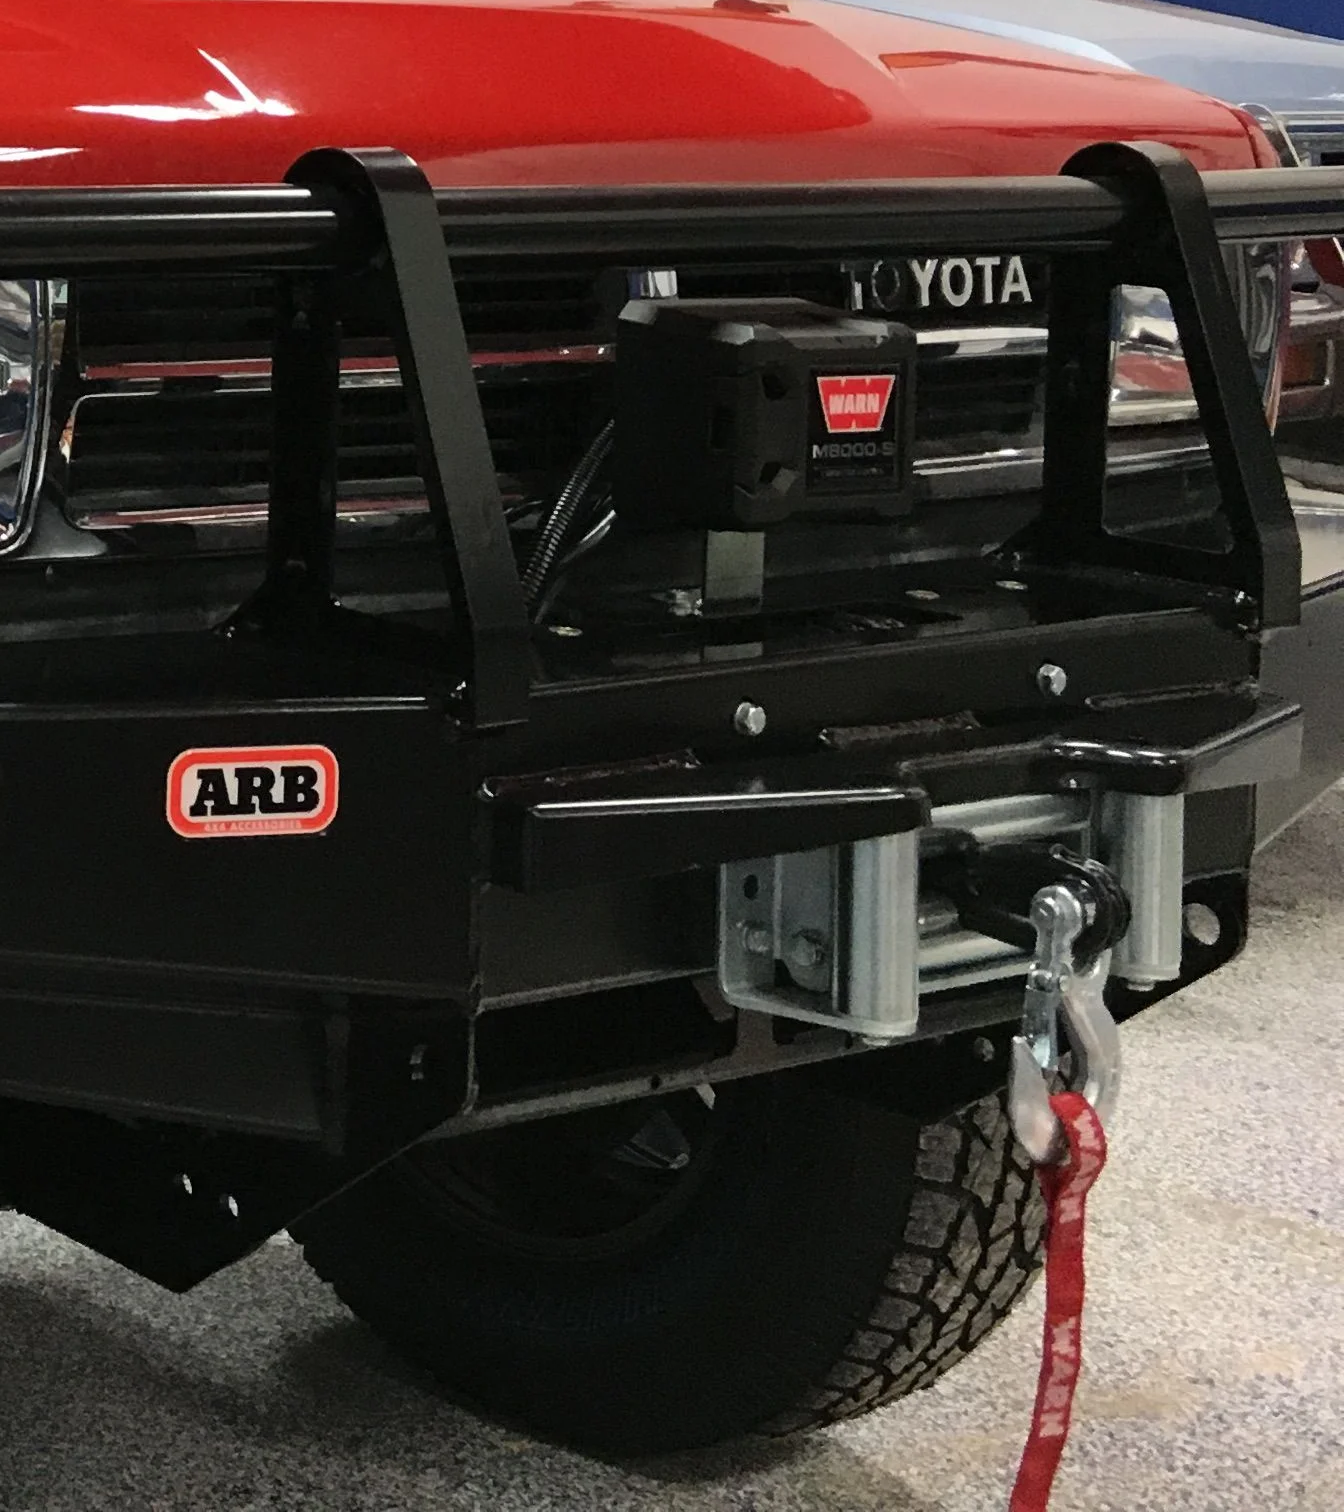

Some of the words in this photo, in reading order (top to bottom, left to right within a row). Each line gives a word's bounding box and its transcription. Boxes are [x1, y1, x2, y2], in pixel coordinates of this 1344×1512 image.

[840, 255, 1033, 311] TOYOTA
[829, 393, 880, 415] WARN
[189, 765, 321, 817] ARB
[1039, 1316, 1076, 1438] WARN
